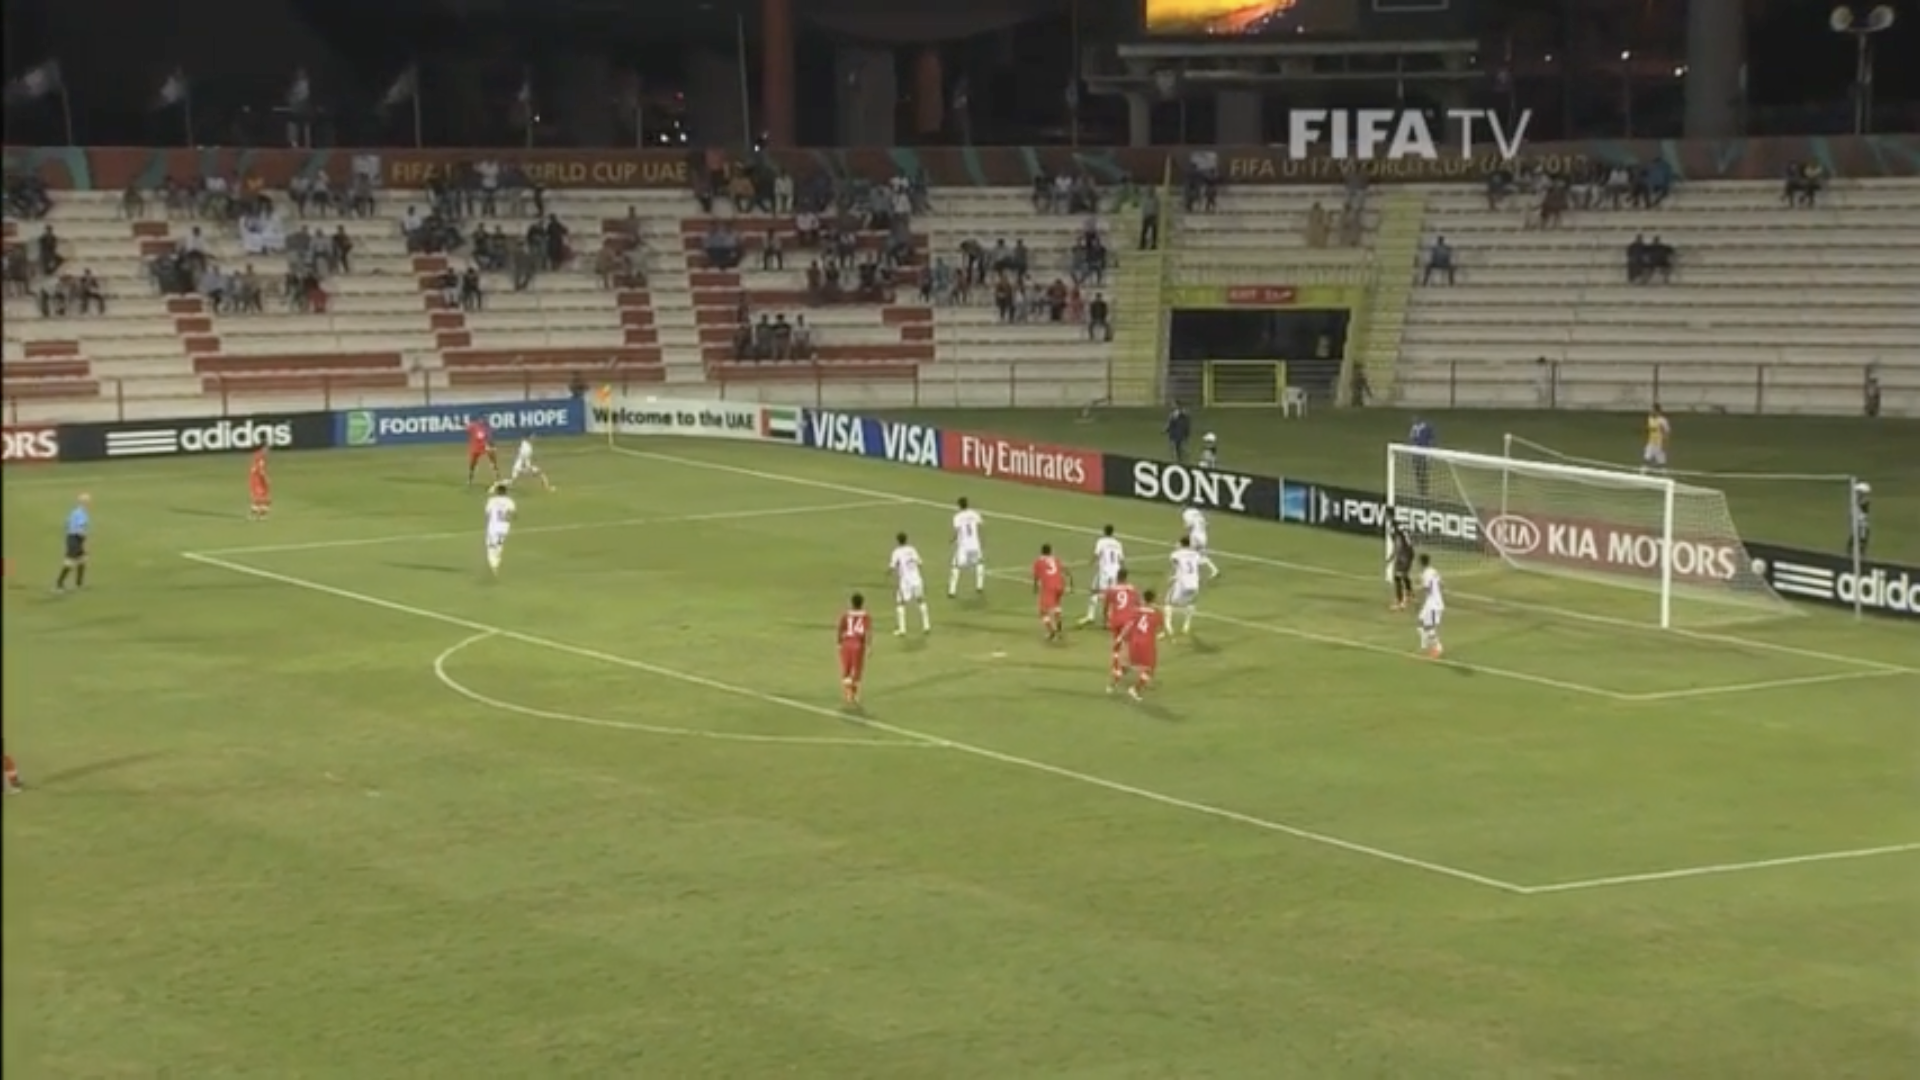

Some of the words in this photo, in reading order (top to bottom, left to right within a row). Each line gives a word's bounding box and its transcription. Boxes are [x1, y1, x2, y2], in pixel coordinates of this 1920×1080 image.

[592, 161, 637, 182] CUP
[642, 160, 688, 182] UAE
[1229, 157, 1276, 178] FIFA
[488, 411, 515, 429] OR
[520, 408, 568, 427] HOPE
[593, 407, 671, 425] Welcome
[677, 410, 695, 425] to
[698, 409, 722, 427] the
[726, 412, 754, 430] UAE
[180, 420, 292, 451] adidas
[811, 410, 866, 455] VISA
[881, 421, 939, 468] VISA
[962, 435, 992, 476] Fly
[997, 441, 1085, 484] Emirates
[1134, 461, 1251, 511] SONY
[1548, 523, 1598, 561] KIA
[1608, 532, 1736, 580] MOTORS
[1045, 557, 1058, 575] 3
[1116, 590, 1129, 611] 9
[846, 617, 865, 636] 14
[1137, 614, 1150, 634] 4
